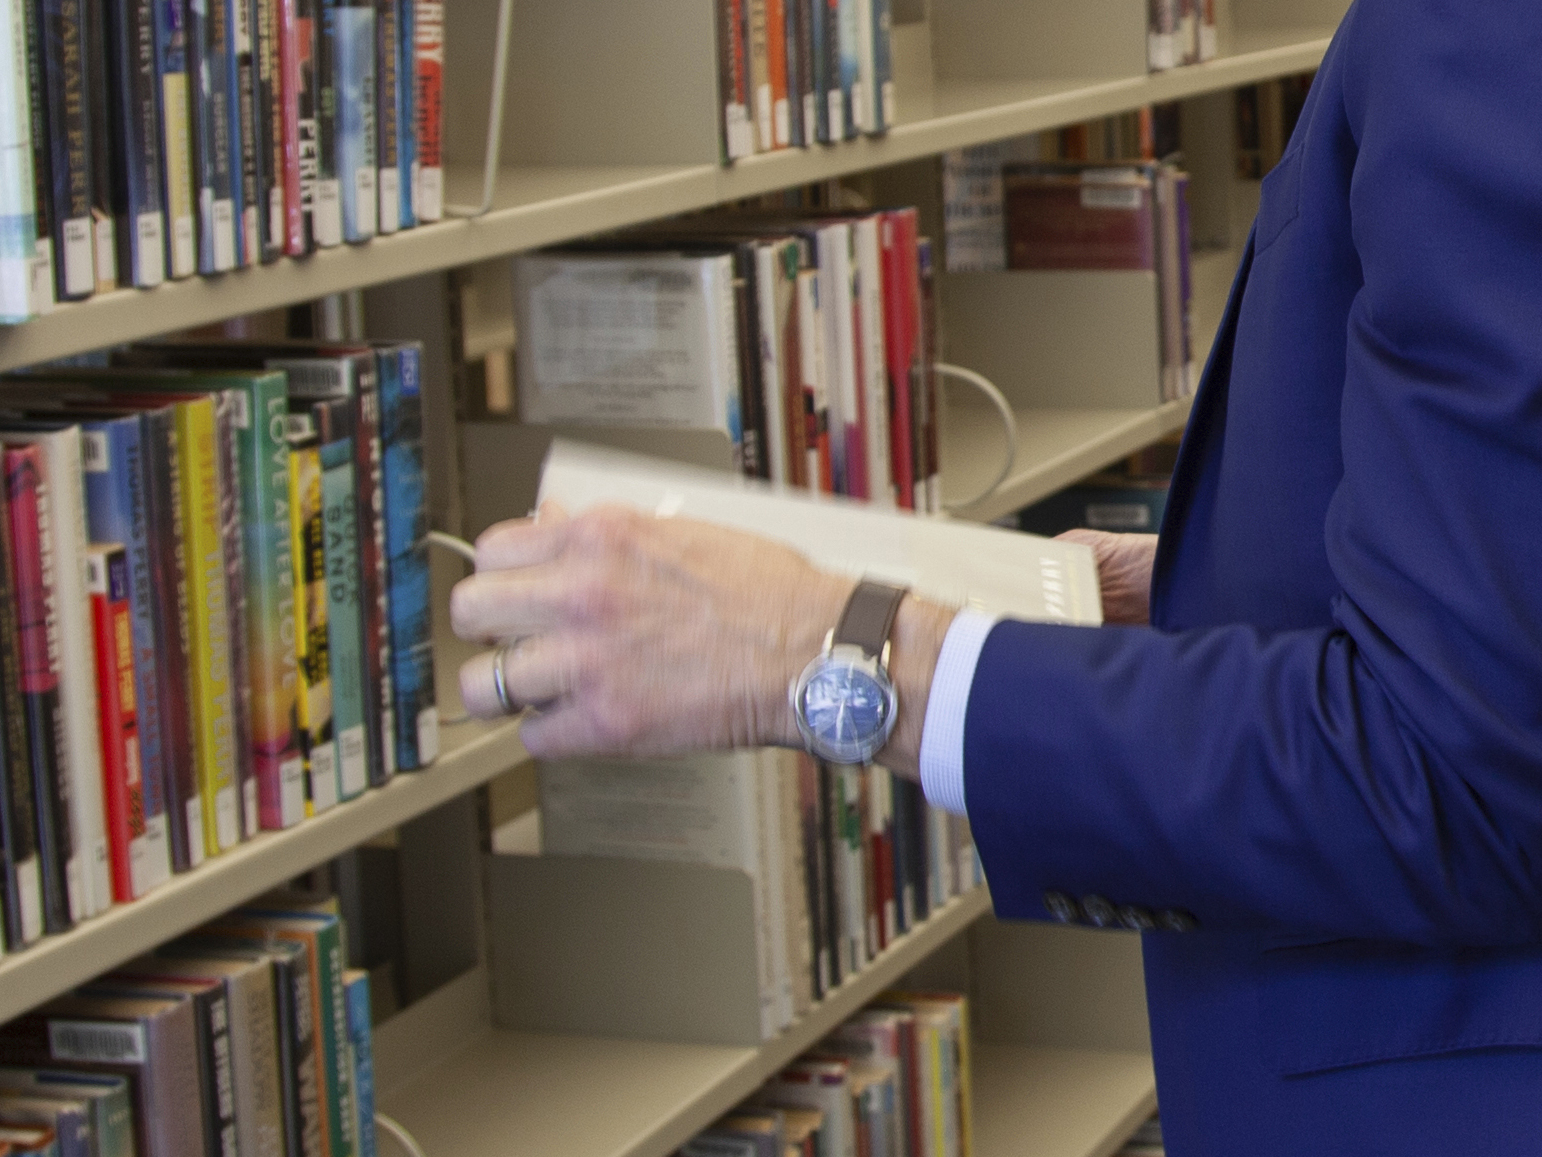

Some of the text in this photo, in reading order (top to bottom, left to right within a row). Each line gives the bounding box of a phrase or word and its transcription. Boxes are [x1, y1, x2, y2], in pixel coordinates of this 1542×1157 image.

[61, 0, 83, 116] SARAH
[384, 11, 396, 100] THOMAS
[67, 130, 87, 216] PERR
[299, 118, 318, 213] PERRY
[126, 444, 145, 539] THOMAS
[132, 546, 149, 622] PERRY
[268, 397, 299, 690] LOVE AFTER LOVE
[327, 505, 345, 604] SAND
[205, 549, 227, 681] THOMAS
[213, 695, 236, 790] PERRY
